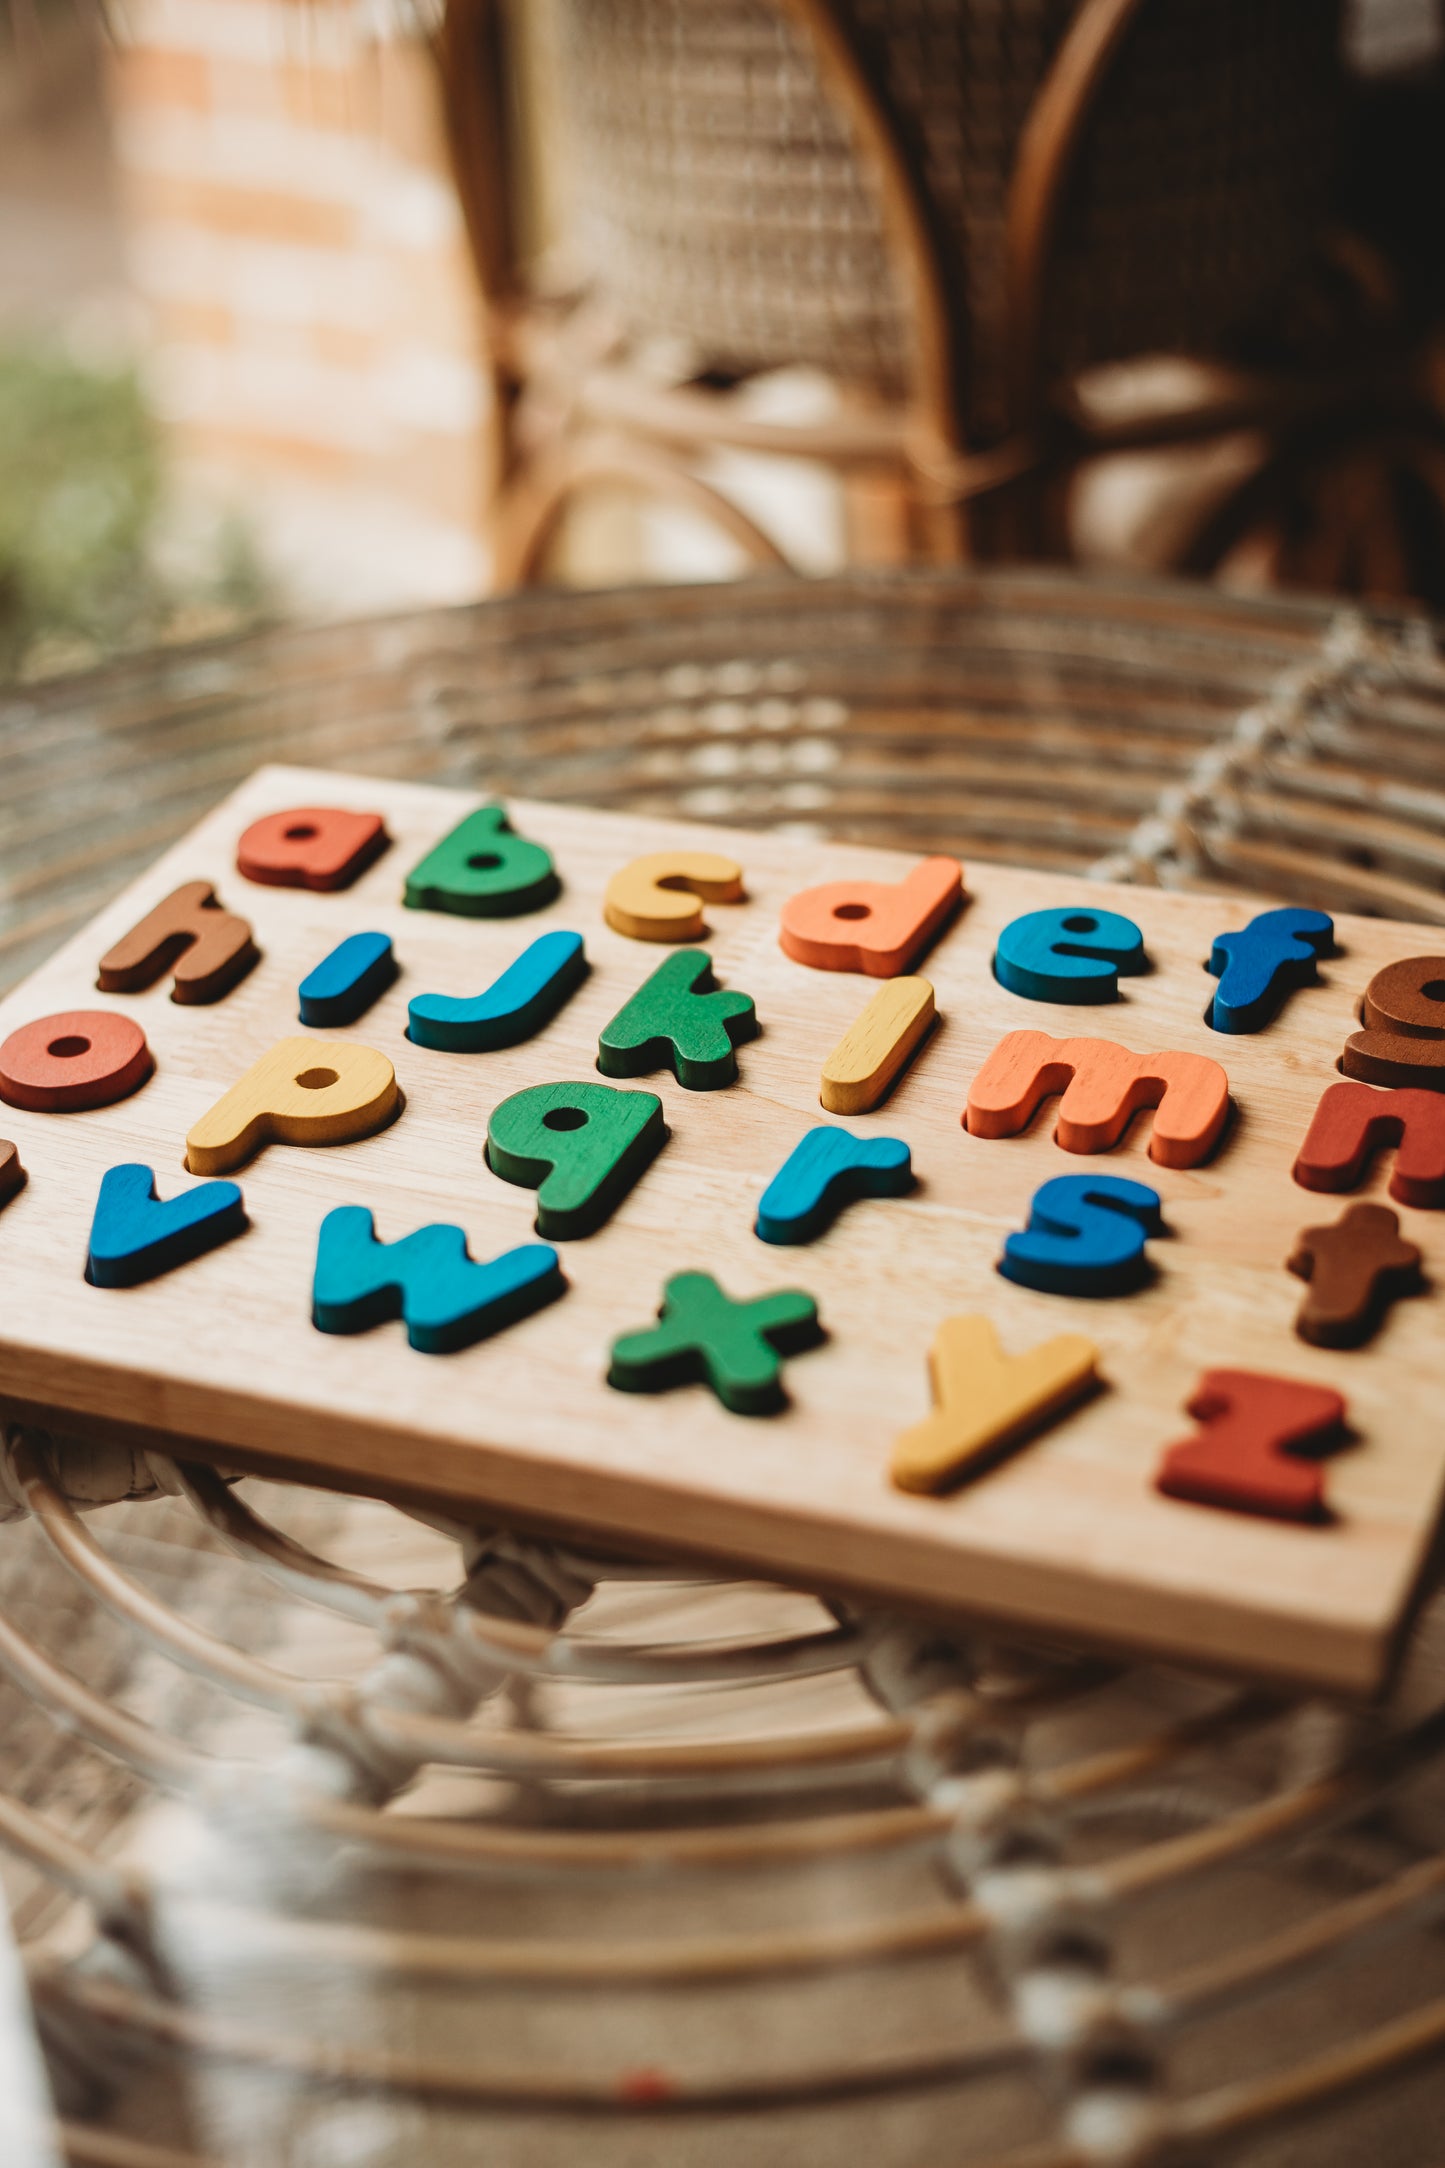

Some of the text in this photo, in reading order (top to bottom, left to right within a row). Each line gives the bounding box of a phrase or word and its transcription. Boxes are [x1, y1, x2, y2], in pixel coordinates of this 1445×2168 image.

[96, 879, 259, 1004] h
[963, 1029, 1235, 1170] m
[1293, 1082, 1445, 1209] n
[236, 806, 388, 891] a
[402, 805, 560, 916] b
[603, 850, 746, 942] c
[779, 855, 966, 978] d
[993, 906, 1148, 1005] e
[1205, 907, 1336, 1034] f
[184, 1036, 401, 1177] p
[484, 1080, 670, 1240] q
[754, 1125, 916, 1245] r
[997, 1173, 1167, 1297] s
[1288, 1200, 1425, 1349] t
